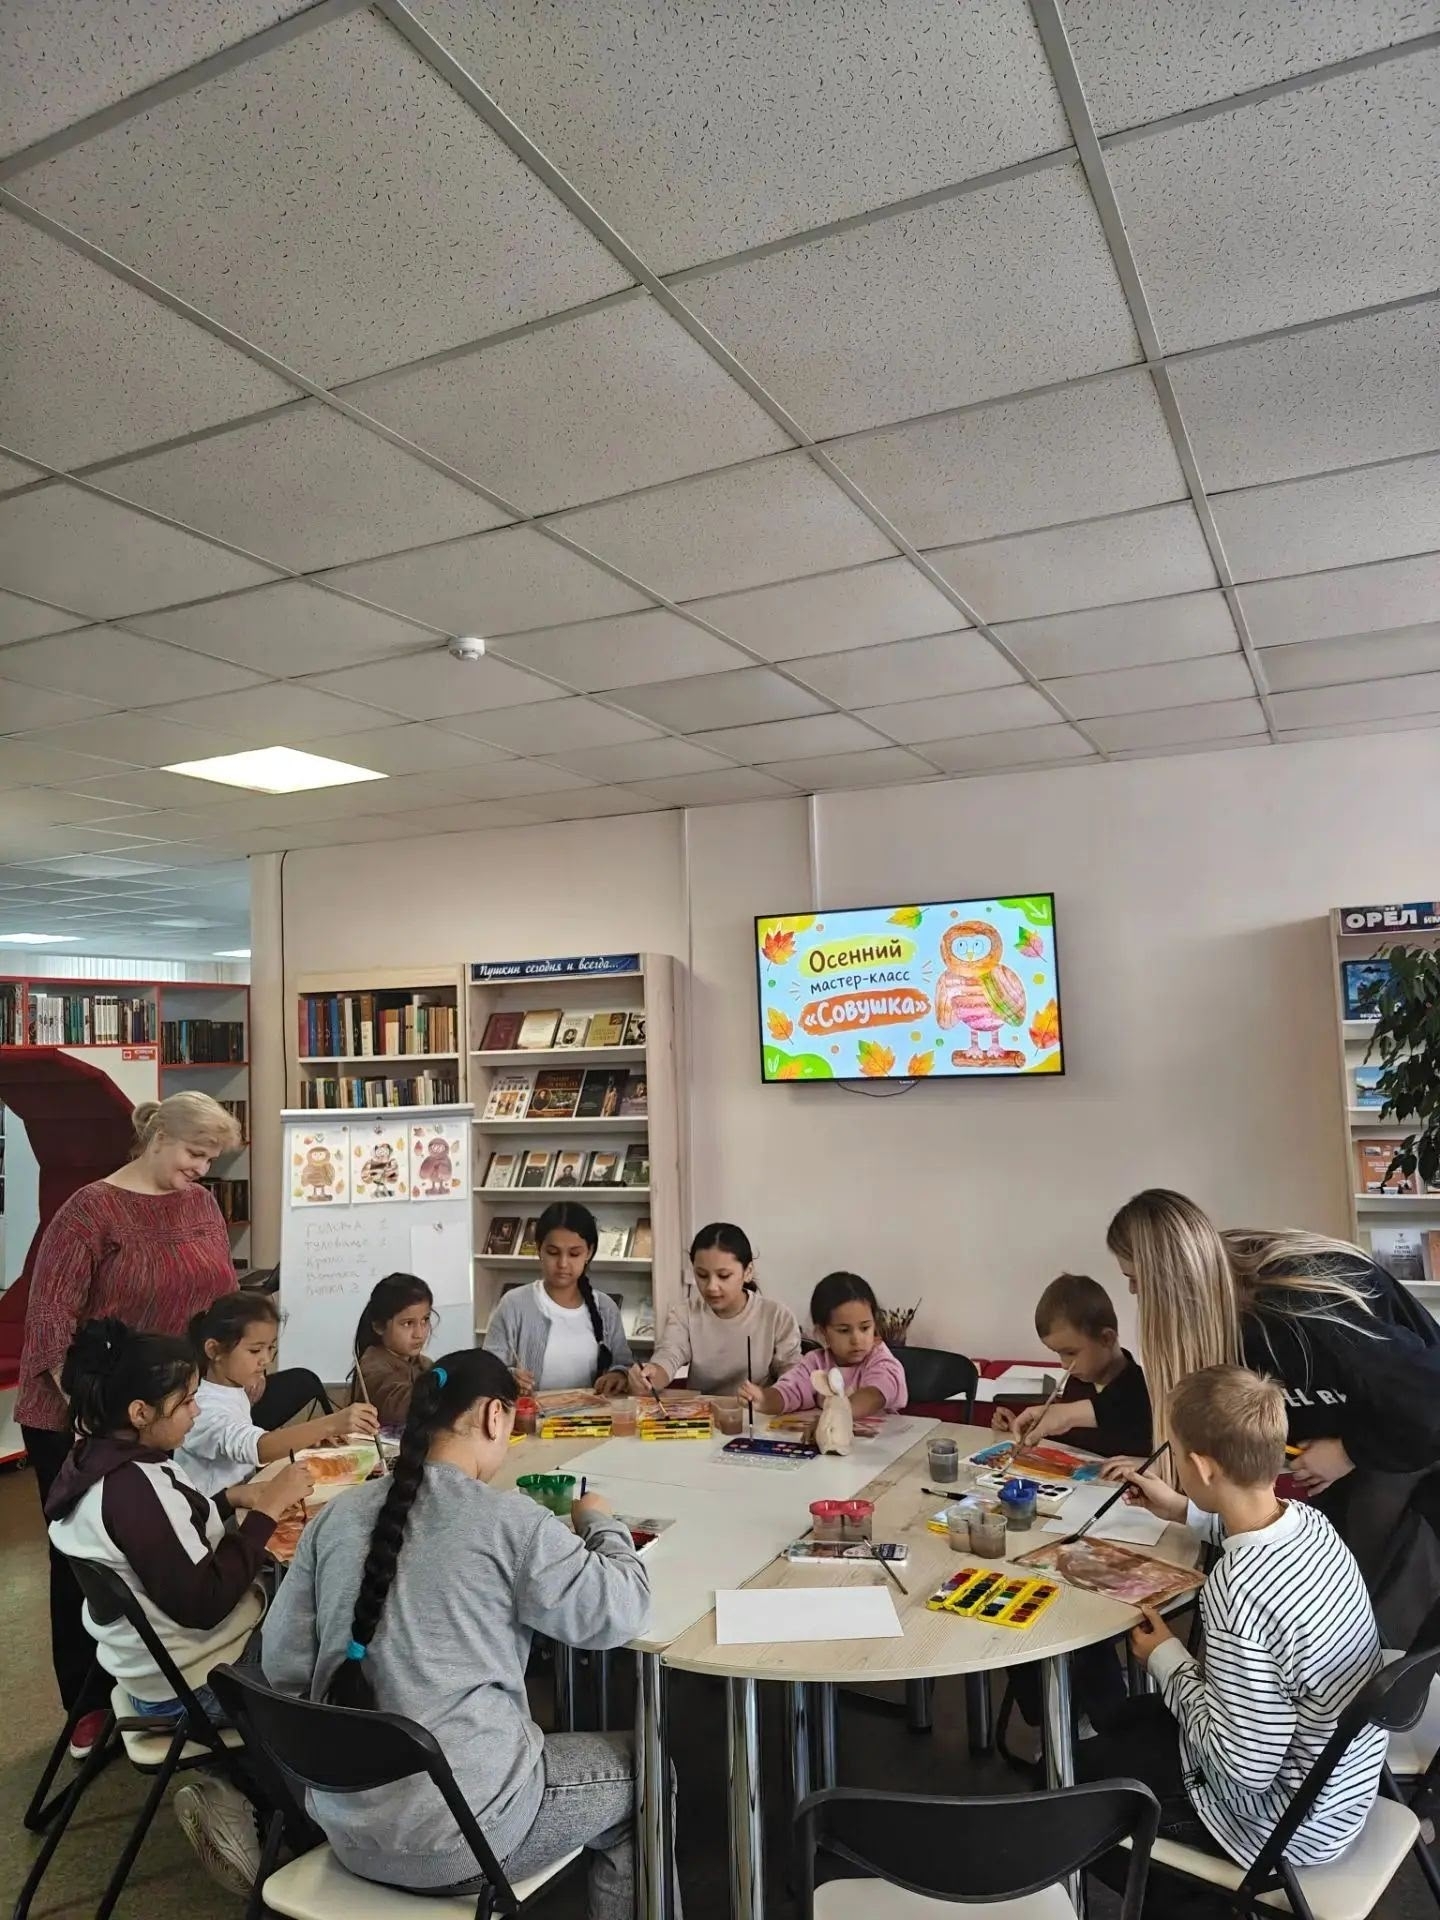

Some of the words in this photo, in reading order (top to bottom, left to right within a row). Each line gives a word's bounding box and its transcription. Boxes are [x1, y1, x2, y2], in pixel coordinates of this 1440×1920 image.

[1346, 905, 1418, 929] ОРЁЛ
[809, 939, 902, 973] Осенний
[479, 964, 521, 981] Пушкин
[525, 960, 562, 974] сегодня
[567, 963, 575, 971] и
[810, 971, 911, 994] мастер-класс
[804, 996, 928, 1027] «Совушка»
